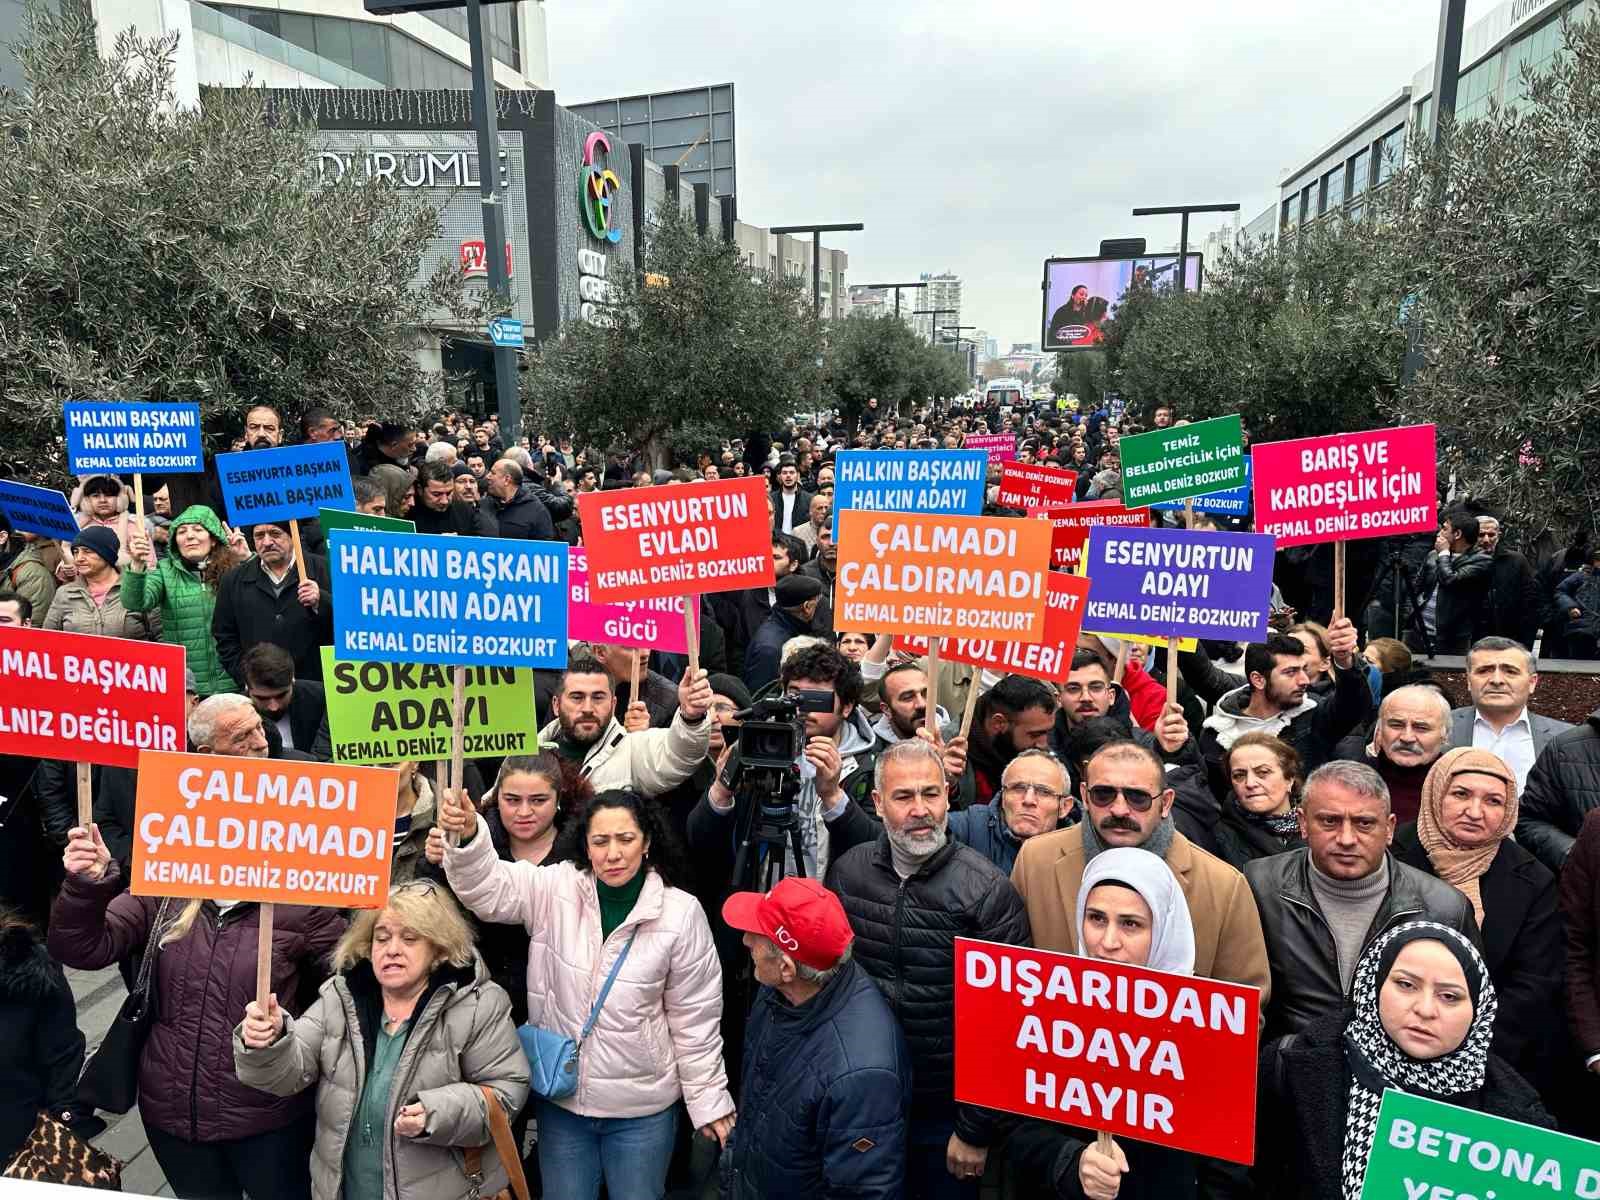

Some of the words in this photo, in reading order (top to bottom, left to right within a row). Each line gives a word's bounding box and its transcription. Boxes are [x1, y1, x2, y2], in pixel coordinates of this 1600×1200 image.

[70, 411, 126, 427] HALKIN
[130, 410, 195, 430] BAŞKANI
[84, 433, 139, 449] HALKIN
[143, 432, 187, 448] ADAYI
[1162, 434, 1200, 452] TEMİZ
[75, 456, 112, 467] KEMAL
[115, 453, 147, 467] DENİZ
[150, 455, 197, 467] BOZKURT
[226, 464, 293, 484] ESENYURTA
[296, 459, 341, 479] BAŞKAN
[841, 460, 904, 481] HALKIN
[907, 460, 981, 486] BAŞKANI
[1125, 450, 1213, 478] BELEDİYECİLİK
[1216, 444, 1241, 462] İÇİN
[1301, 444, 1359, 474] BARIŞ
[1362, 441, 1388, 465] VE
[1004, 469, 1025, 479] KEMAL
[1025, 472, 1044, 482] DENİZ
[1044, 475, 1073, 487] BOZKURT
[1031, 483, 1041, 494] İLE
[1129, 481, 1162, 499] KEMAL
[1164, 475, 1194, 493] DENİZ
[1195, 467, 1239, 486] BOZKURT
[1270, 472, 1378, 511] KARDEŞLİK
[1382, 466, 1421, 504] İÇİN
[234, 490, 285, 511] KEMAL
[287, 483, 344, 506] BAŞKAN
[601, 493, 748, 532] ESENYURTUN
[851, 489, 913, 509] HALKIN
[919, 488, 967, 509] ADAYI
[1001, 491, 1021, 505] TAM
[1203, 498, 1244, 510] BOZKURT
[1080, 513, 1105, 527] DENİZ
[1106, 513, 1145, 526] BOZKURT
[1264, 521, 1312, 539] KEMAL
[1315, 510, 1358, 535] DENİZ
[1361, 506, 1430, 529] BOZKURT
[639, 526, 718, 557] EVLADI
[869, 522, 1017, 558] ÇALMADI
[1104, 540, 1254, 572] ESENYURTUN
[340, 545, 438, 578] HALKIN
[446, 549, 560, 589] BAŞKANI
[597, 569, 648, 589] KEMAL
[650, 559, 694, 584] DENİZ
[698, 556, 765, 578] BOZKURT
[840, 562, 1042, 600] ÇALDIRMADI
[1141, 571, 1209, 598] ADAYI
[361, 587, 457, 619] HALKIN
[464, 592, 541, 622] ADAYI
[843, 602, 899, 623] KEMAL
[902, 601, 953, 626] DENİZ
[956, 612, 1035, 631] BOZKURT
[1088, 601, 1137, 620] KEMAL
[1140, 601, 1185, 624] DENİZ
[1188, 608, 1260, 628] BOZKURT
[345, 631, 408, 652] KEMAL
[412, 629, 468, 654] DENİZ
[472, 638, 556, 657] BOZKURT
[604, 617, 658, 641] GÜCÜ
[0, 648, 58, 680] MAL
[63, 655, 167, 695] BAŞKAN
[0, 705, 54, 737] LNIZ
[60, 707, 177, 751] DEĞİLDİR
[336, 742, 393, 761] KEMAL
[400, 732, 446, 755] DENİZ
[452, 733, 526, 753] OZKURT
[178, 767, 358, 811] ÇALMADI
[140, 812, 387, 860] ÇALDIRMADI
[144, 860, 214, 884] KEMAL
[219, 860, 281, 888] DENİZ
[286, 869, 379, 896] BOZKURT
[965, 950, 1246, 1035] DIŞARIDAN
[1016, 1015, 1185, 1080] ADAYA
[1025, 1068, 1174, 1134] HAYIR
[1388, 1118, 1562, 1191] BETONA
